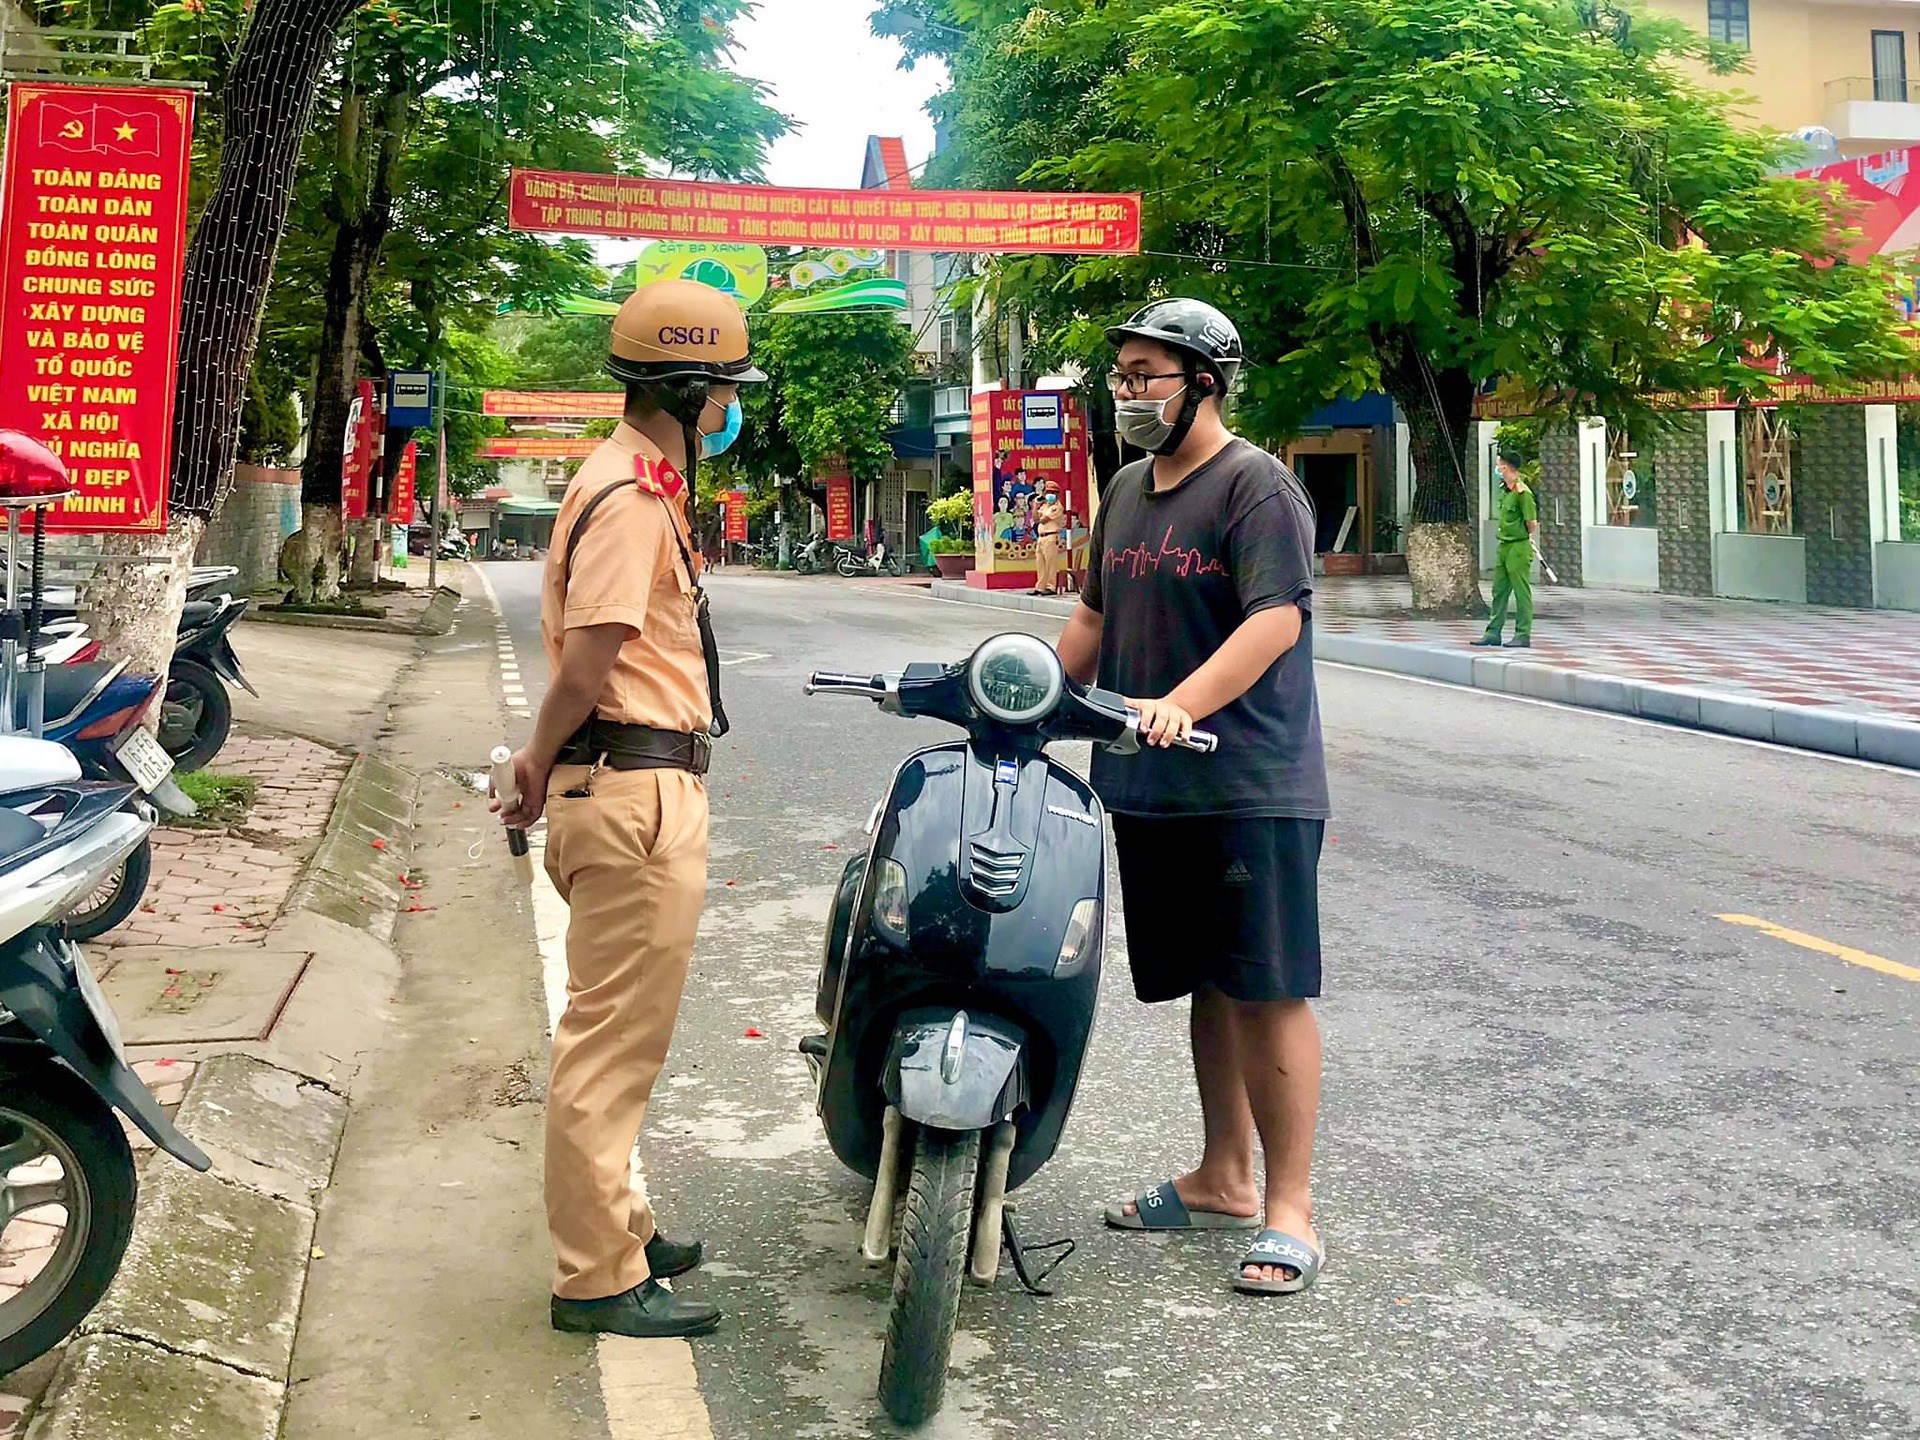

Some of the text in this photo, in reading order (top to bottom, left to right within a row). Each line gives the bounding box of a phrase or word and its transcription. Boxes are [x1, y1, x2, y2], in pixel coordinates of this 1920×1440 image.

[32, 167, 162, 190] TOÀN ĐẢNG
[38, 194, 152, 216] TOÀN DÂN
[524, 175, 556, 198] ĐẢNG
[694, 189, 708, 209] VÀ
[744, 192, 767, 212] DÂN
[809, 196, 829, 215] CÁT
[853, 195, 886, 217] QUYẾT
[1011, 201, 1027, 223] LỢI
[1098, 202, 1128, 221] 2021:
[28, 221, 158, 243] TOÀN QUÂN
[565, 208, 602, 227] TRUNG
[630, 209, 668, 231] PHÓNG
[697, 210, 728, 234] BẰNG
[738, 215, 767, 236] TĂNG
[810, 216, 840, 240] QUẢN
[842, 219, 855, 240] LÝ
[858, 223, 873, 241] DU
[876, 224, 900, 244] LỊCH
[910, 222, 931, 242] XÂY
[934, 224, 963, 245] DỰNG
[966, 223, 996, 243] NÔNG
[999, 224, 1027, 244] THÔN
[25, 245, 156, 270] ĐỒNG LÒNG
[712, 244, 745, 253] XANH
[23, 276, 155, 297] CHUNG SỨC
[30, 301, 145, 326] XÂY DỰNG
[26, 327, 145, 354] VÀ BẢO VỆ
[658, 326, 720, 345] CSGT
[35, 352, 133, 377] TỔ QUỐC
[27, 382, 137, 406] VIỆT NAM
[41, 410, 119, 435] XÃ HỘI
[70, 440, 141, 459] NGHĨA
[85, 469, 130, 489] ĐẸP
[63, 496, 126, 514] MINH
[134, 497, 141, 514] !
